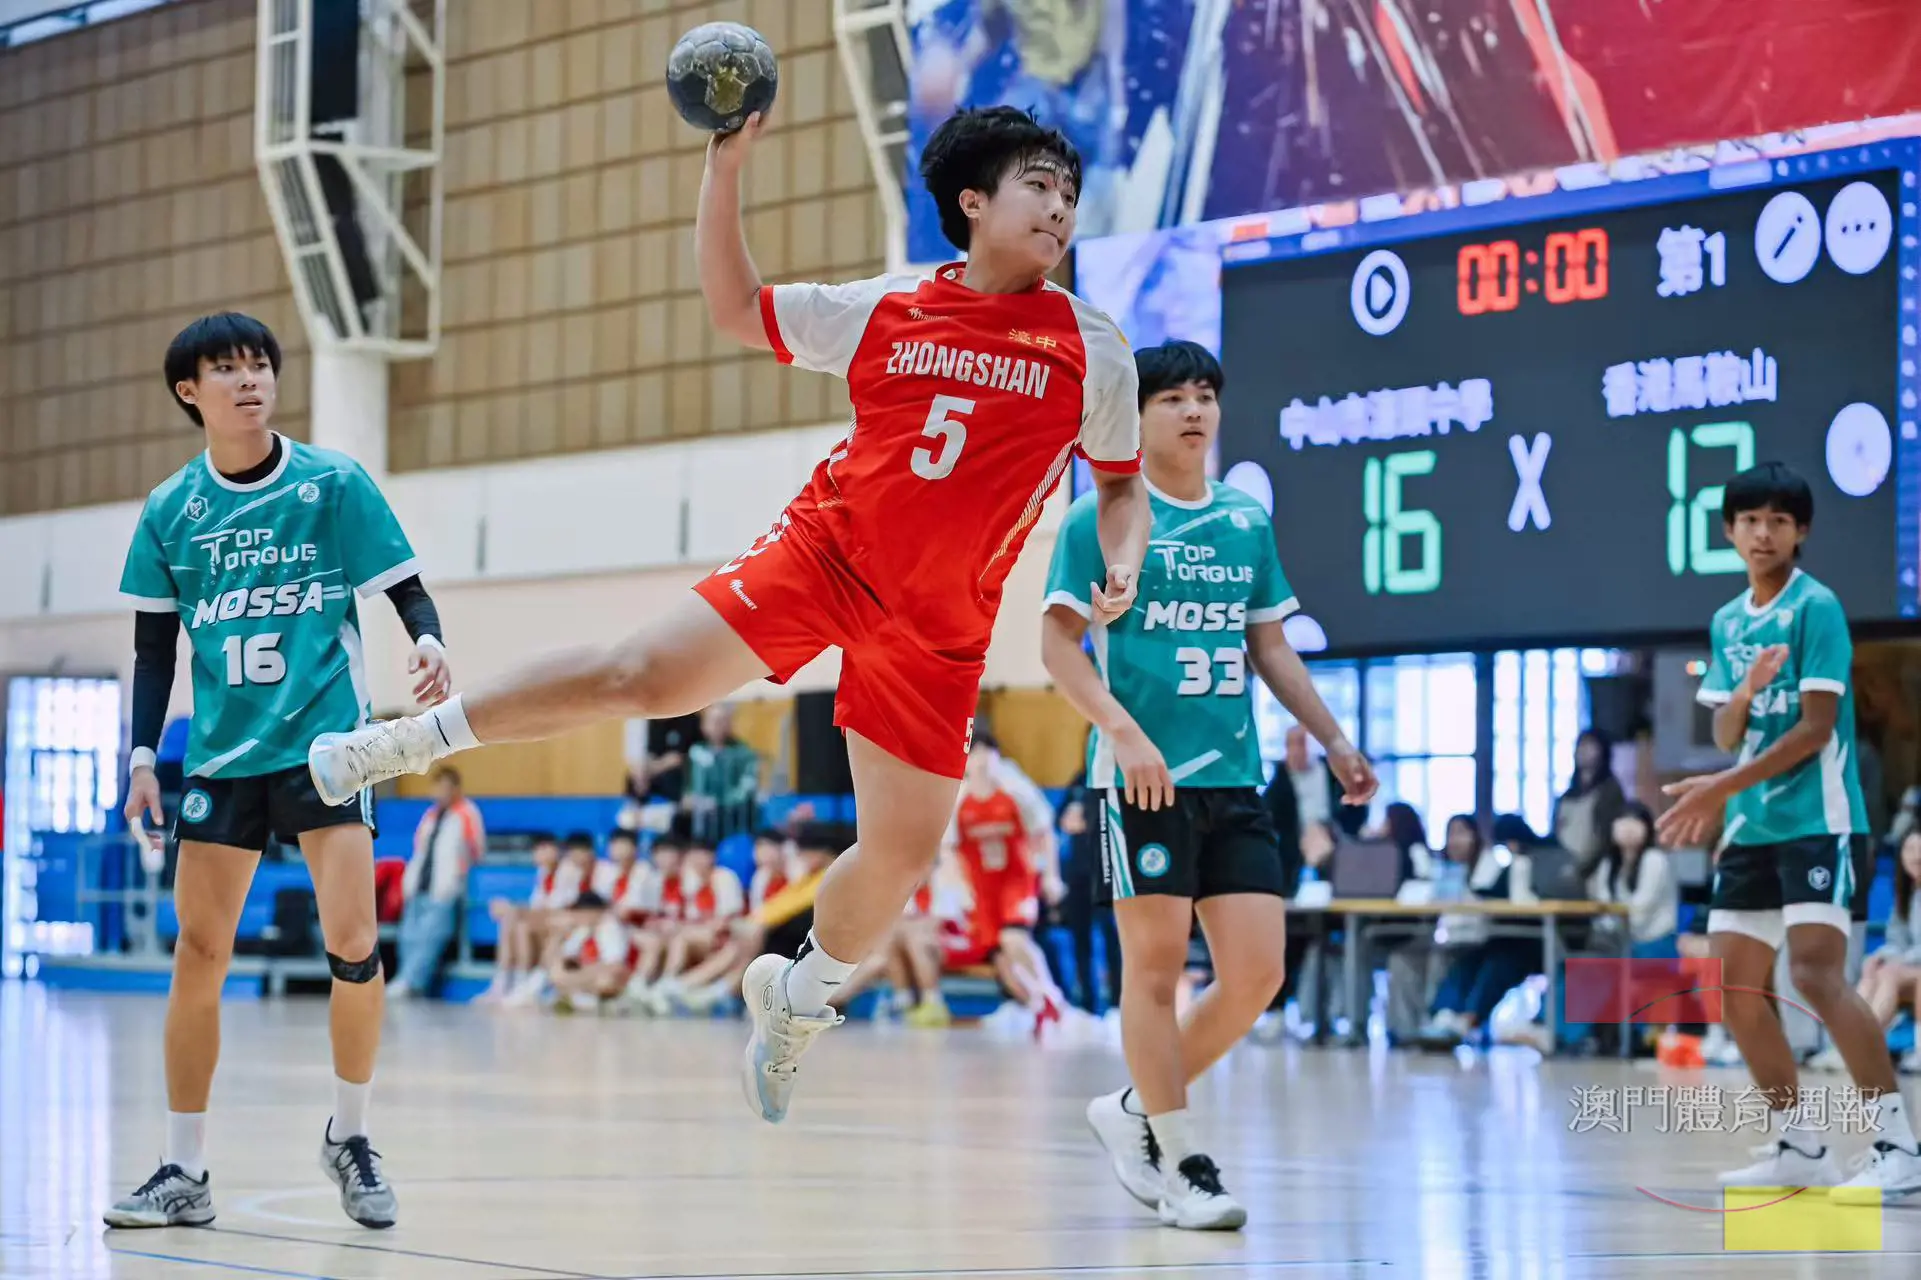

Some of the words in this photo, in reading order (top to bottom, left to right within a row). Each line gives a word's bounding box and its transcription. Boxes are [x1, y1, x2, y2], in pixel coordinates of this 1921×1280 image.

[1457, 229, 1608, 315] 00:00
[1656, 225, 1727, 298] 第1
[886, 341, 1050, 399] ZHONGSHAN
[910, 393, 976, 480] 5
[1362, 450, 1442, 595] 16
[1667, 421, 1756, 576] 12
[190, 528, 274, 562] TOP
[200, 537, 317, 575] TORQUE
[1148, 540, 1216, 570] TOP
[191, 581, 323, 629] MOSSA
[1143, 600, 1247, 632] MOSS
[221, 632, 287, 686] 16
[1175, 646, 1246, 696] 33
